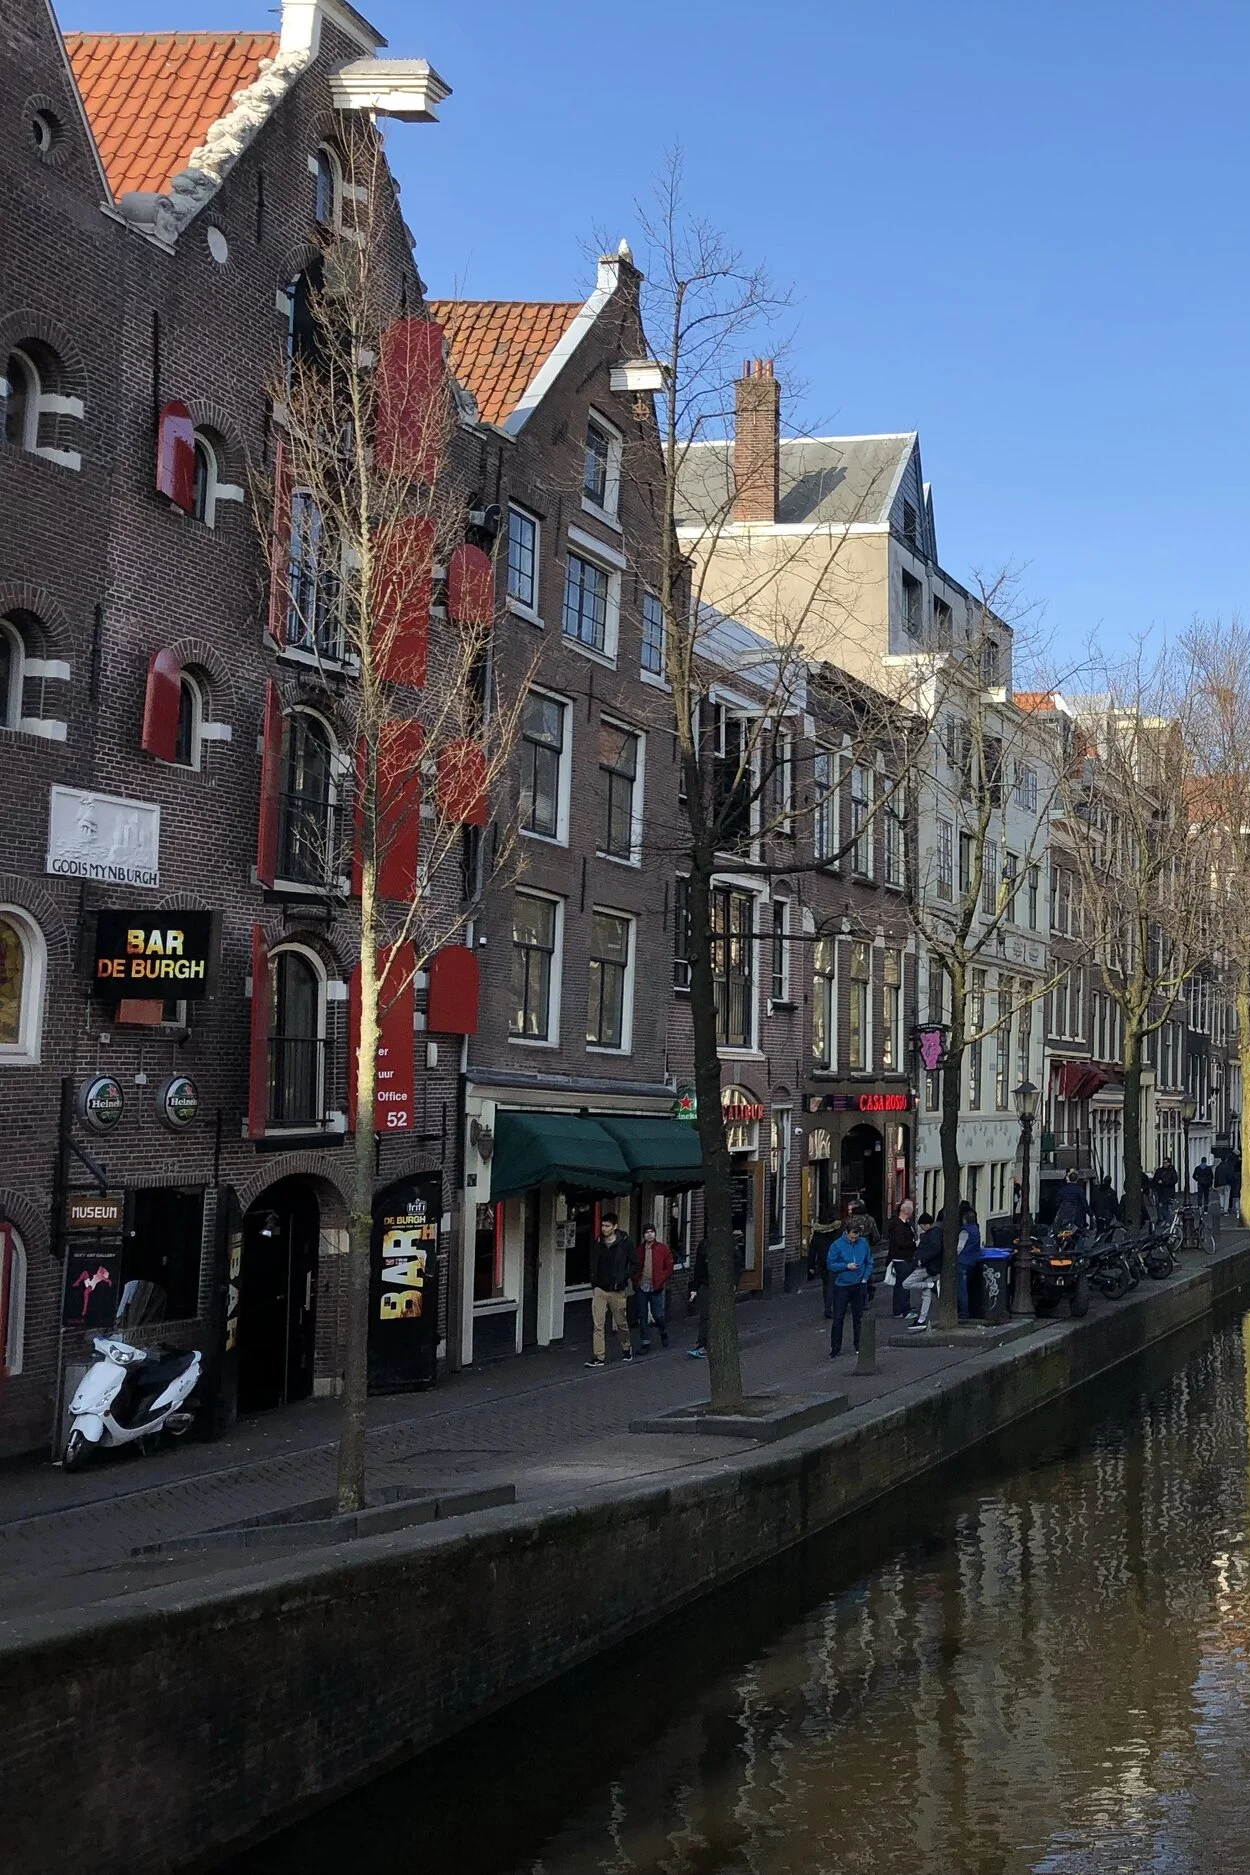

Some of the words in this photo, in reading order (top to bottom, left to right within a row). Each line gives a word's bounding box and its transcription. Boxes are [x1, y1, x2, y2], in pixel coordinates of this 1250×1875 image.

[127, 929, 184, 955] BAR
[96, 958, 126, 978] DE
[131, 959, 205, 979] BURGH
[377, 1091, 408, 1101] Office
[860, 1094, 884, 1111] CASA
[885, 1094, 907, 1111] ROSSO
[386, 1111, 408, 1127] 52
[72, 1206, 118, 1219] MUSEUM
[383, 1216, 396, 1226] DE
[396, 1215, 427, 1225] BURGH
[379, 1229, 427, 1320] BAR
